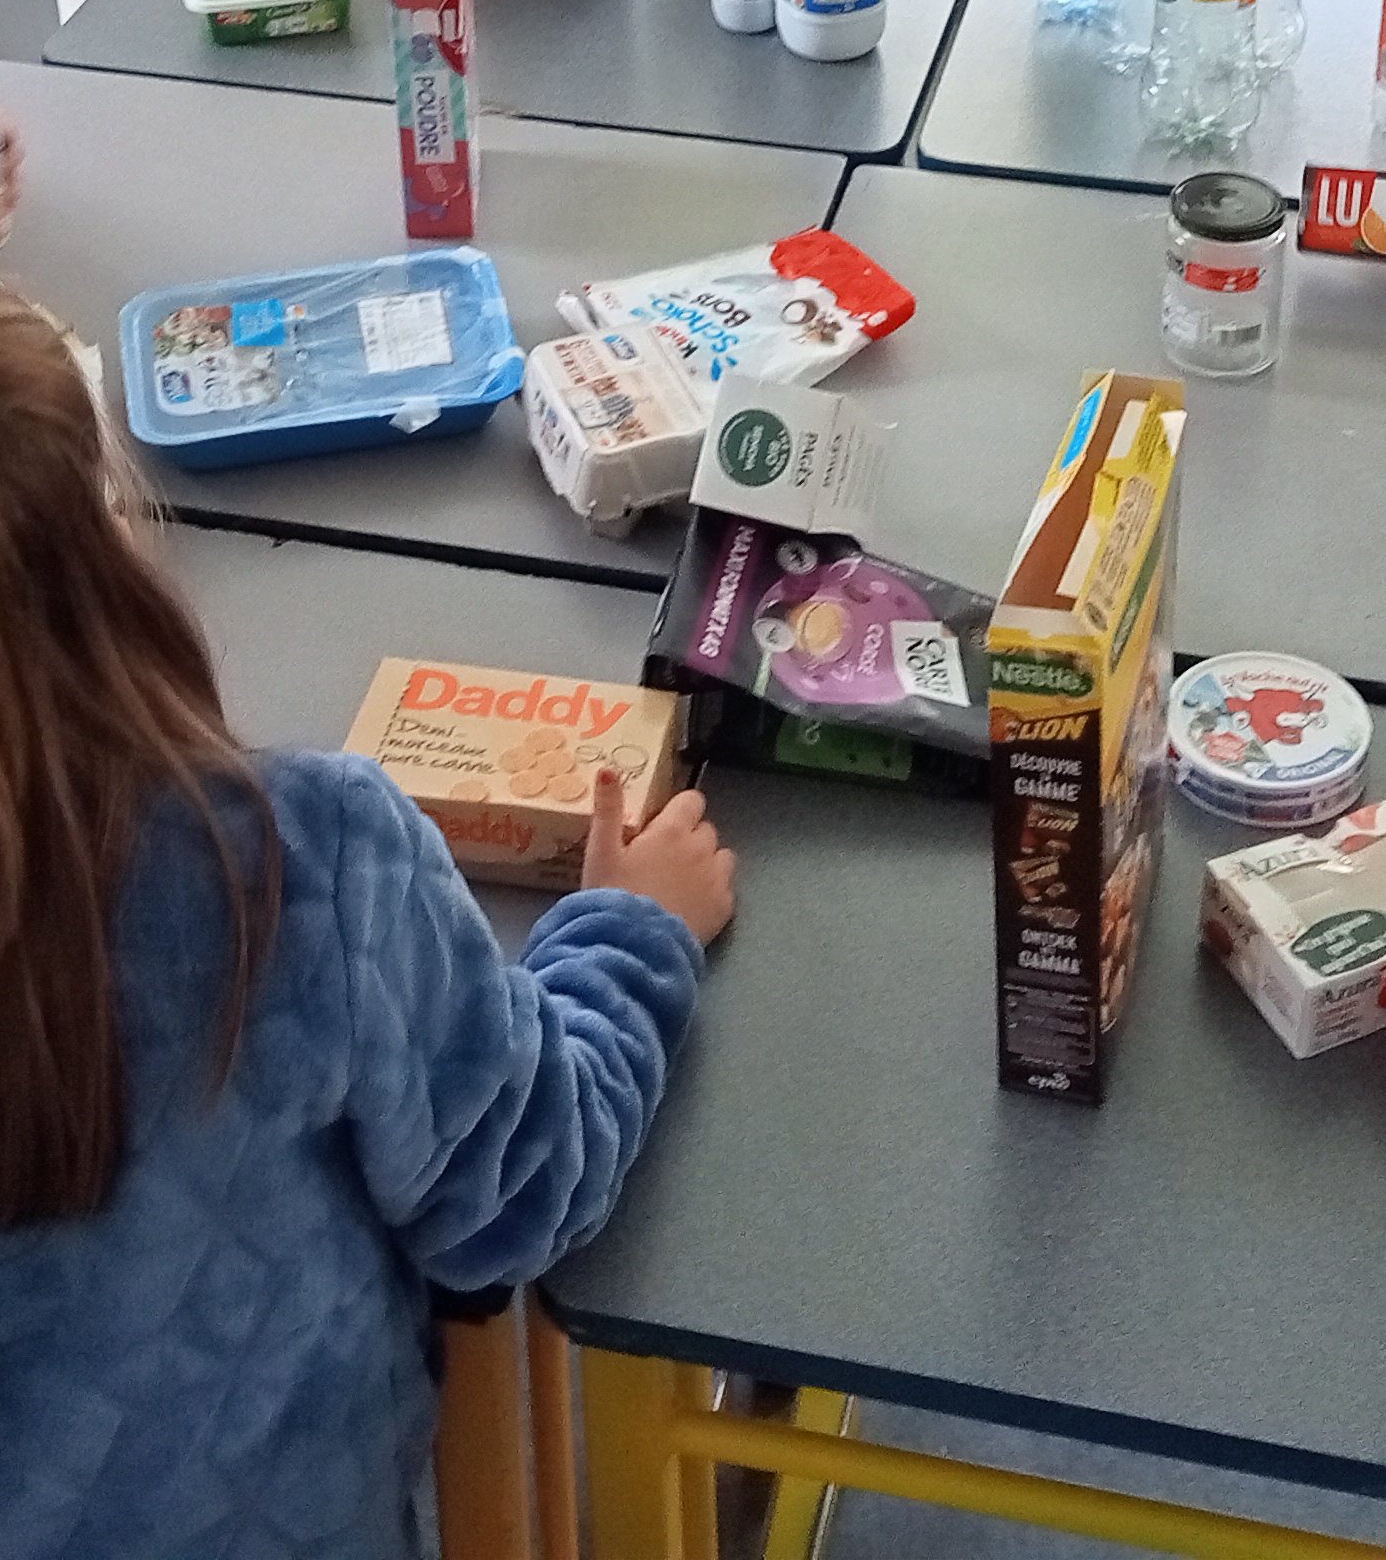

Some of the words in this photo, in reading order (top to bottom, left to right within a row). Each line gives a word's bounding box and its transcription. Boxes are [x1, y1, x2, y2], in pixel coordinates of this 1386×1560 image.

[414, 75, 441, 159] POUDRE
[1317, 175, 1363, 228] LU
[651, 298, 739, 354] Schoko
[689, 292, 751, 328] Bons
[402, 668, 632, 739] Daddy
[387, 738, 488, 756] morceaux
[1018, 713, 1090, 741] LION
[381, 752, 425, 767] pure
[428, 757, 497, 775] canne
